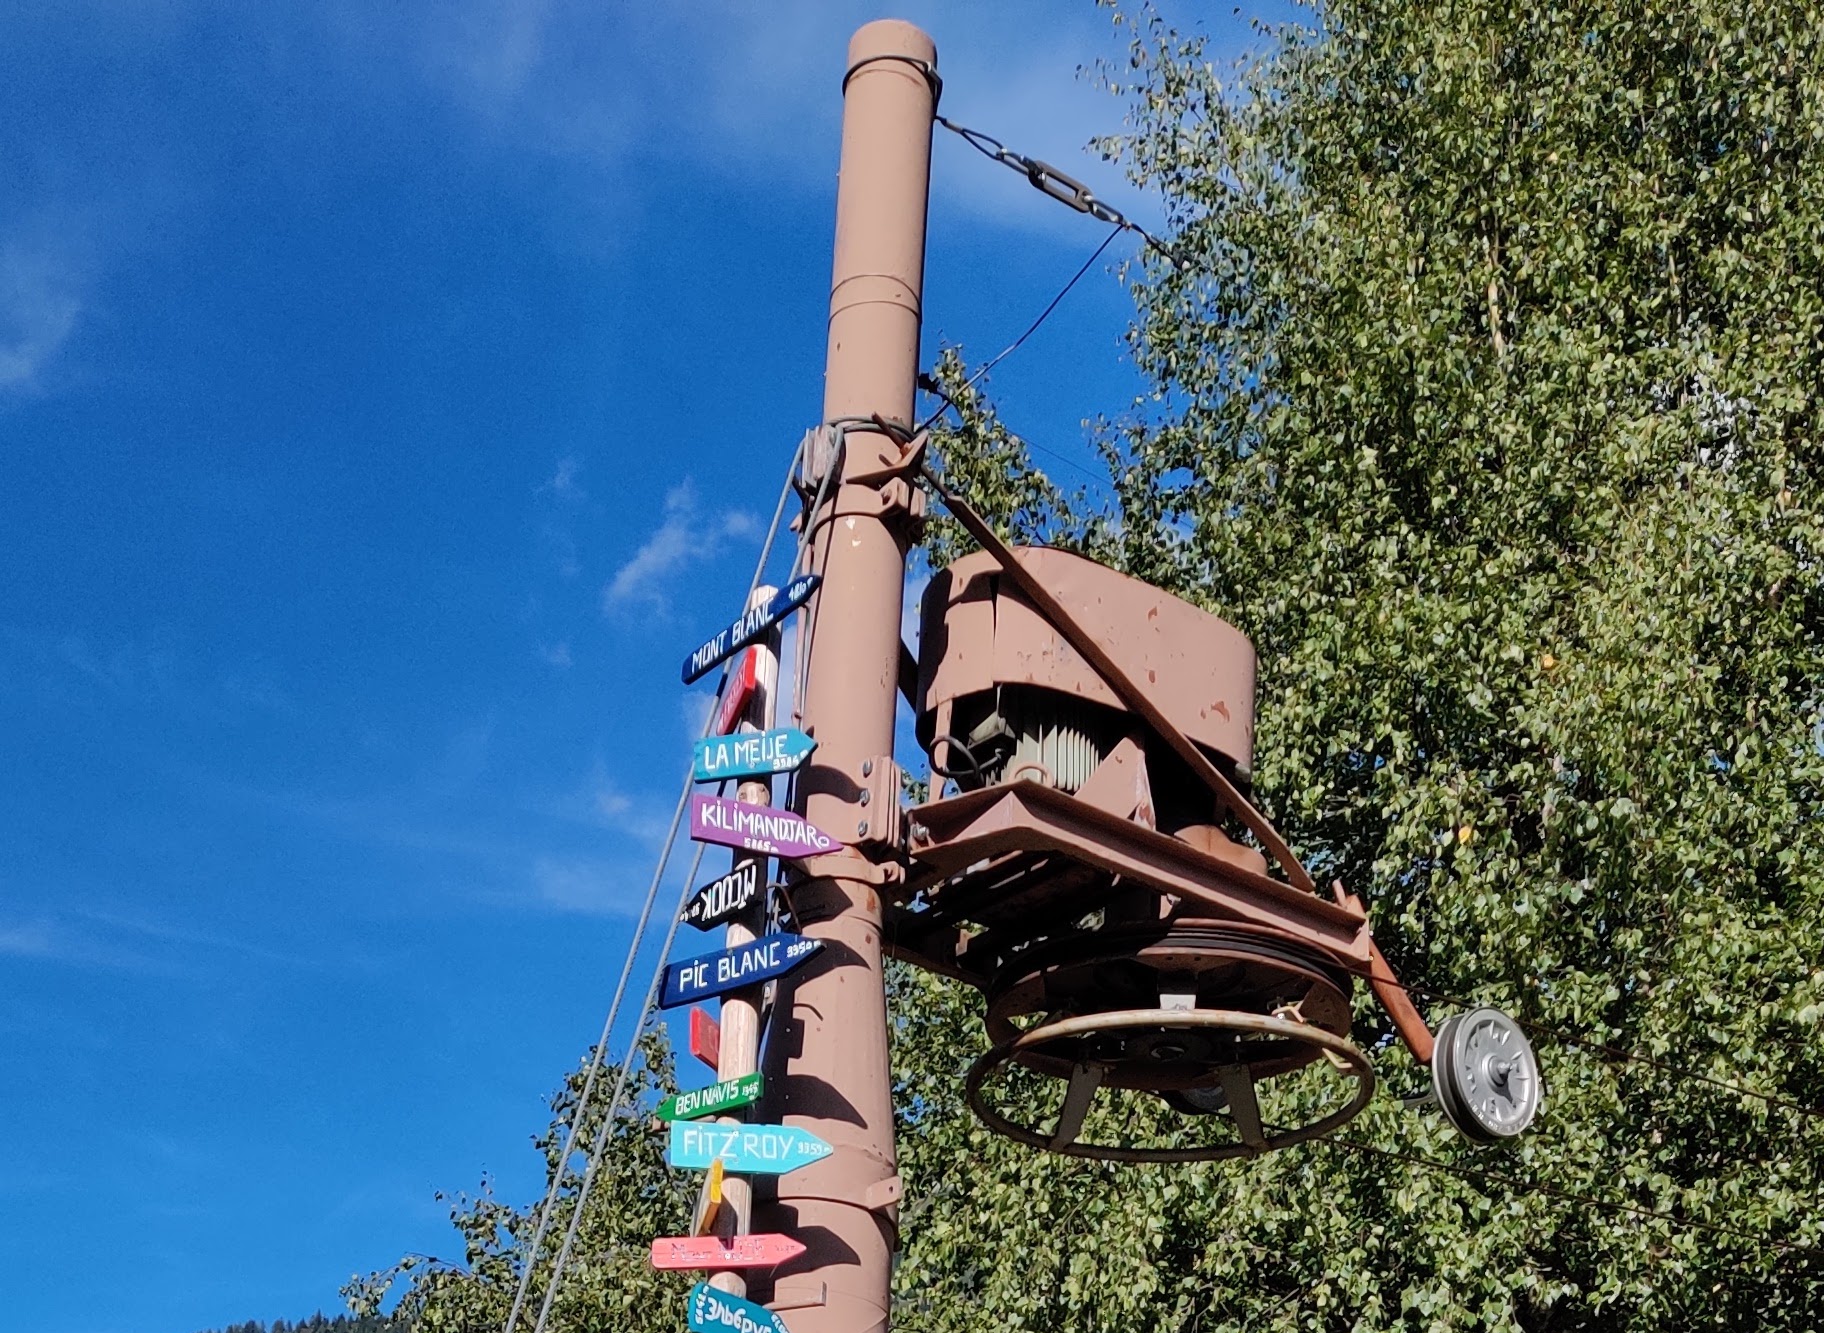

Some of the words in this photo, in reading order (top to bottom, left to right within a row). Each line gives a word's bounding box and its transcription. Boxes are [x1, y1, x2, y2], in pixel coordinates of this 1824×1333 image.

[692, 630, 727, 673] MONT
[732, 597, 773, 646] BLANC
[705, 744, 729, 769] LA
[735, 732, 787, 765] MEIJE
[702, 800, 830, 849] KILIMANDJARO
[679, 960, 709, 992] PIC
[718, 942, 781, 982] BLANC
[675, 1091, 700, 1116] BEN
[702, 1079, 739, 1107] NAVIS
[684, 1126, 739, 1157] FITZ
[744, 1134, 794, 1160] ROY
